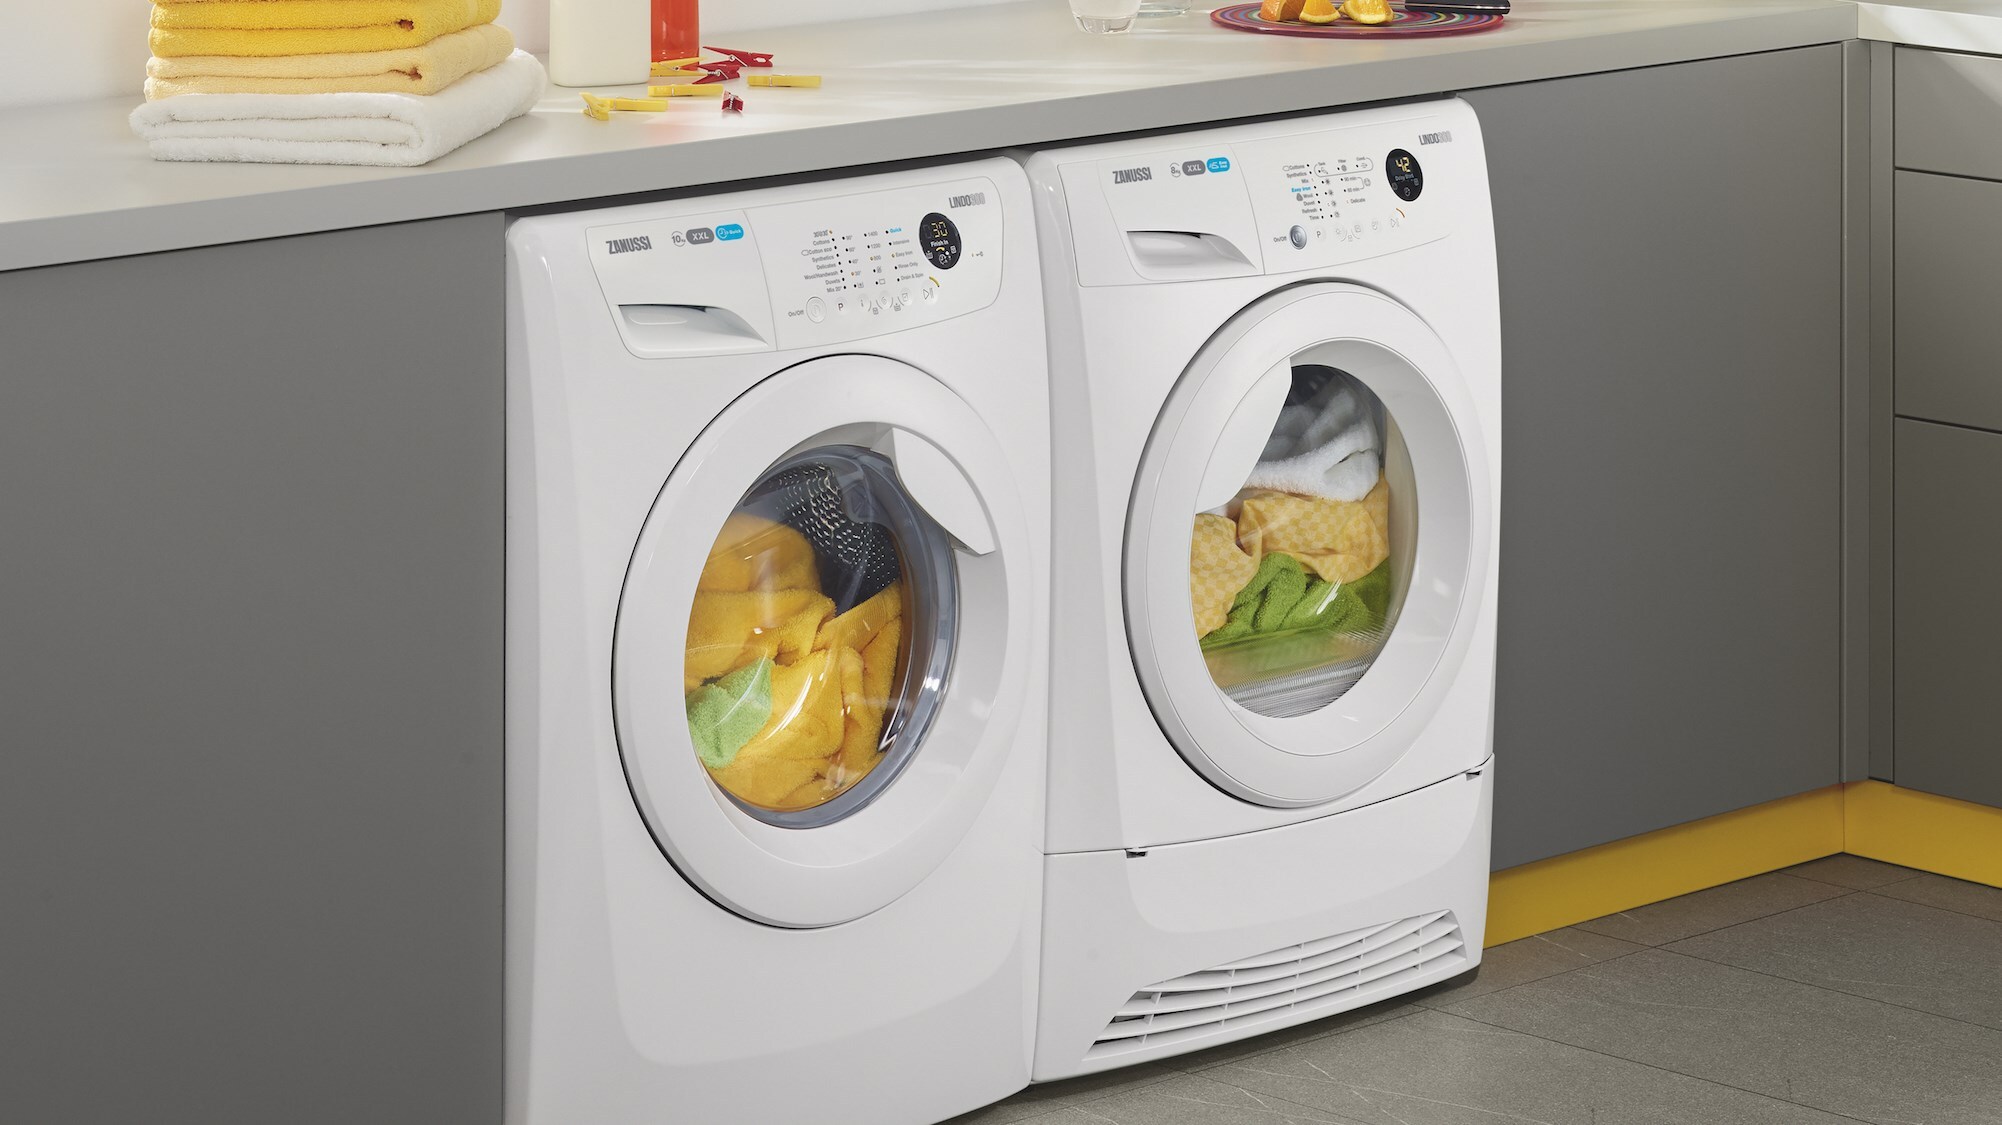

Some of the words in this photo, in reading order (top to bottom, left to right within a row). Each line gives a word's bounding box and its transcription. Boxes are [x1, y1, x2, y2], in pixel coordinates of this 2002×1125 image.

[1187, 163, 1202, 172] XXL
[1395, 157, 1411, 173] 42
[1112, 166, 1153, 184] ZANUSSI
[931, 221, 948, 238] 30
[692, 232, 709, 241] XXL
[606, 236, 652, 254] ZANUSSI
[812, 255, 834, 263] Synthetics
[838, 302, 844, 311] P
